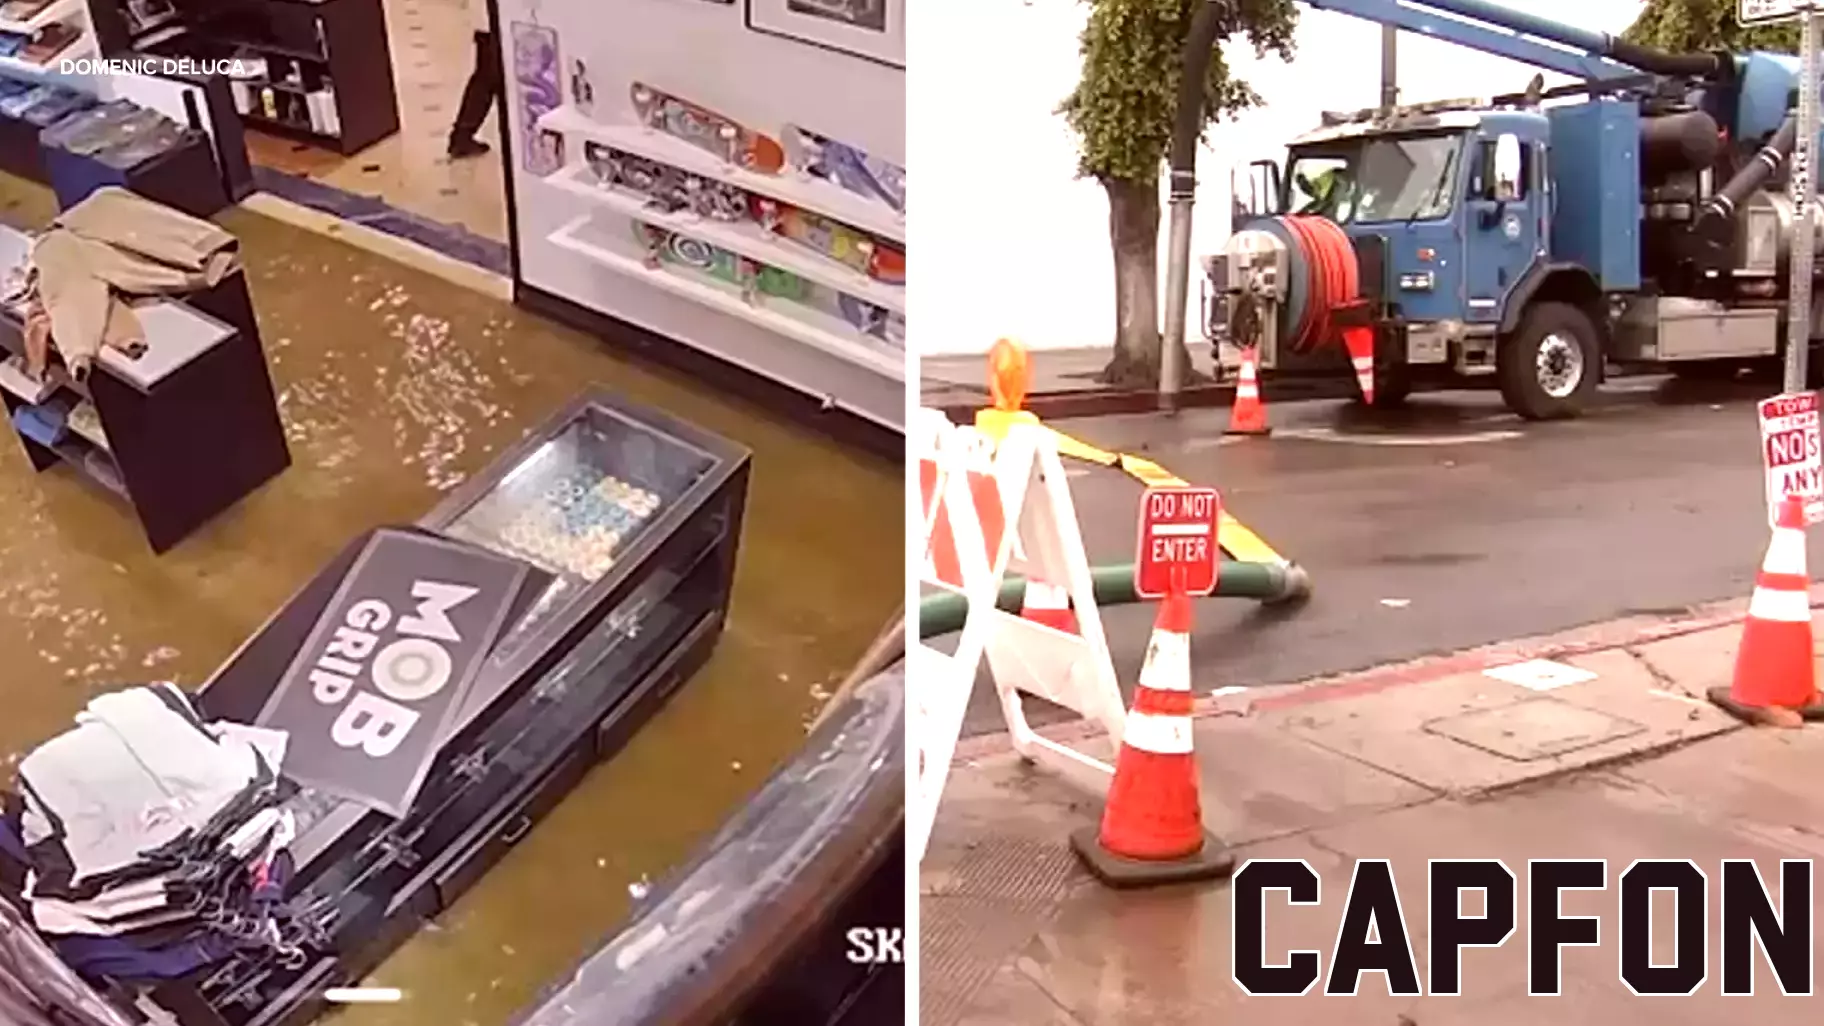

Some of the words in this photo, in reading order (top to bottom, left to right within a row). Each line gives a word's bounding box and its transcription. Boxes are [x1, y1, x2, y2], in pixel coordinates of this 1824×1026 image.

[1776, 396, 1813, 415] TOW
[1771, 431, 1803, 464] NO
[1782, 466, 1824, 494] ANY
[1151, 494, 1176, 518] DO
[1182, 494, 1215, 518] NOT
[1151, 537, 1208, 562] ENTER
[308, 600, 392, 704] GRIP
[331, 580, 481, 757] MOB
